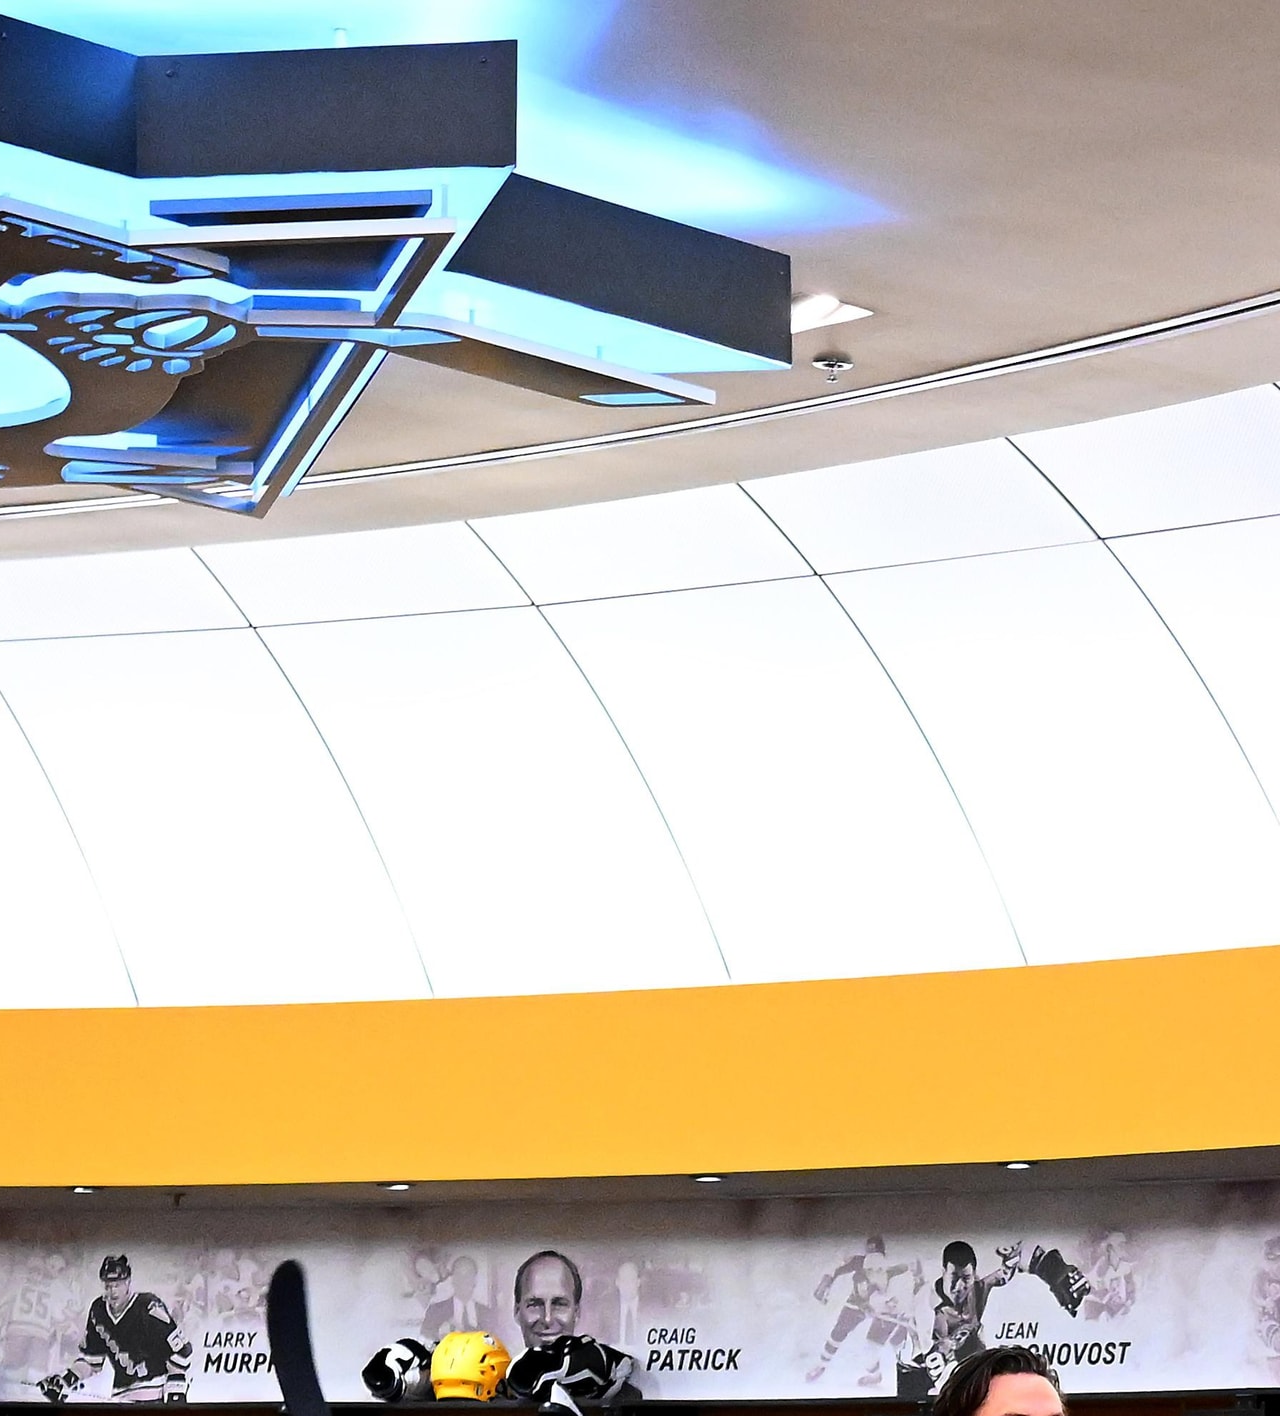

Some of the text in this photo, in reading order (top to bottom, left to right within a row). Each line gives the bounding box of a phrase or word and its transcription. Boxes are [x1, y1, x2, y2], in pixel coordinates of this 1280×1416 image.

[203, 1331, 258, 1348] LARRY
[646, 1327, 697, 1345] CRAIG
[994, 1321, 1039, 1340] JEAN
[645, 1348, 742, 1372] PATRICK
